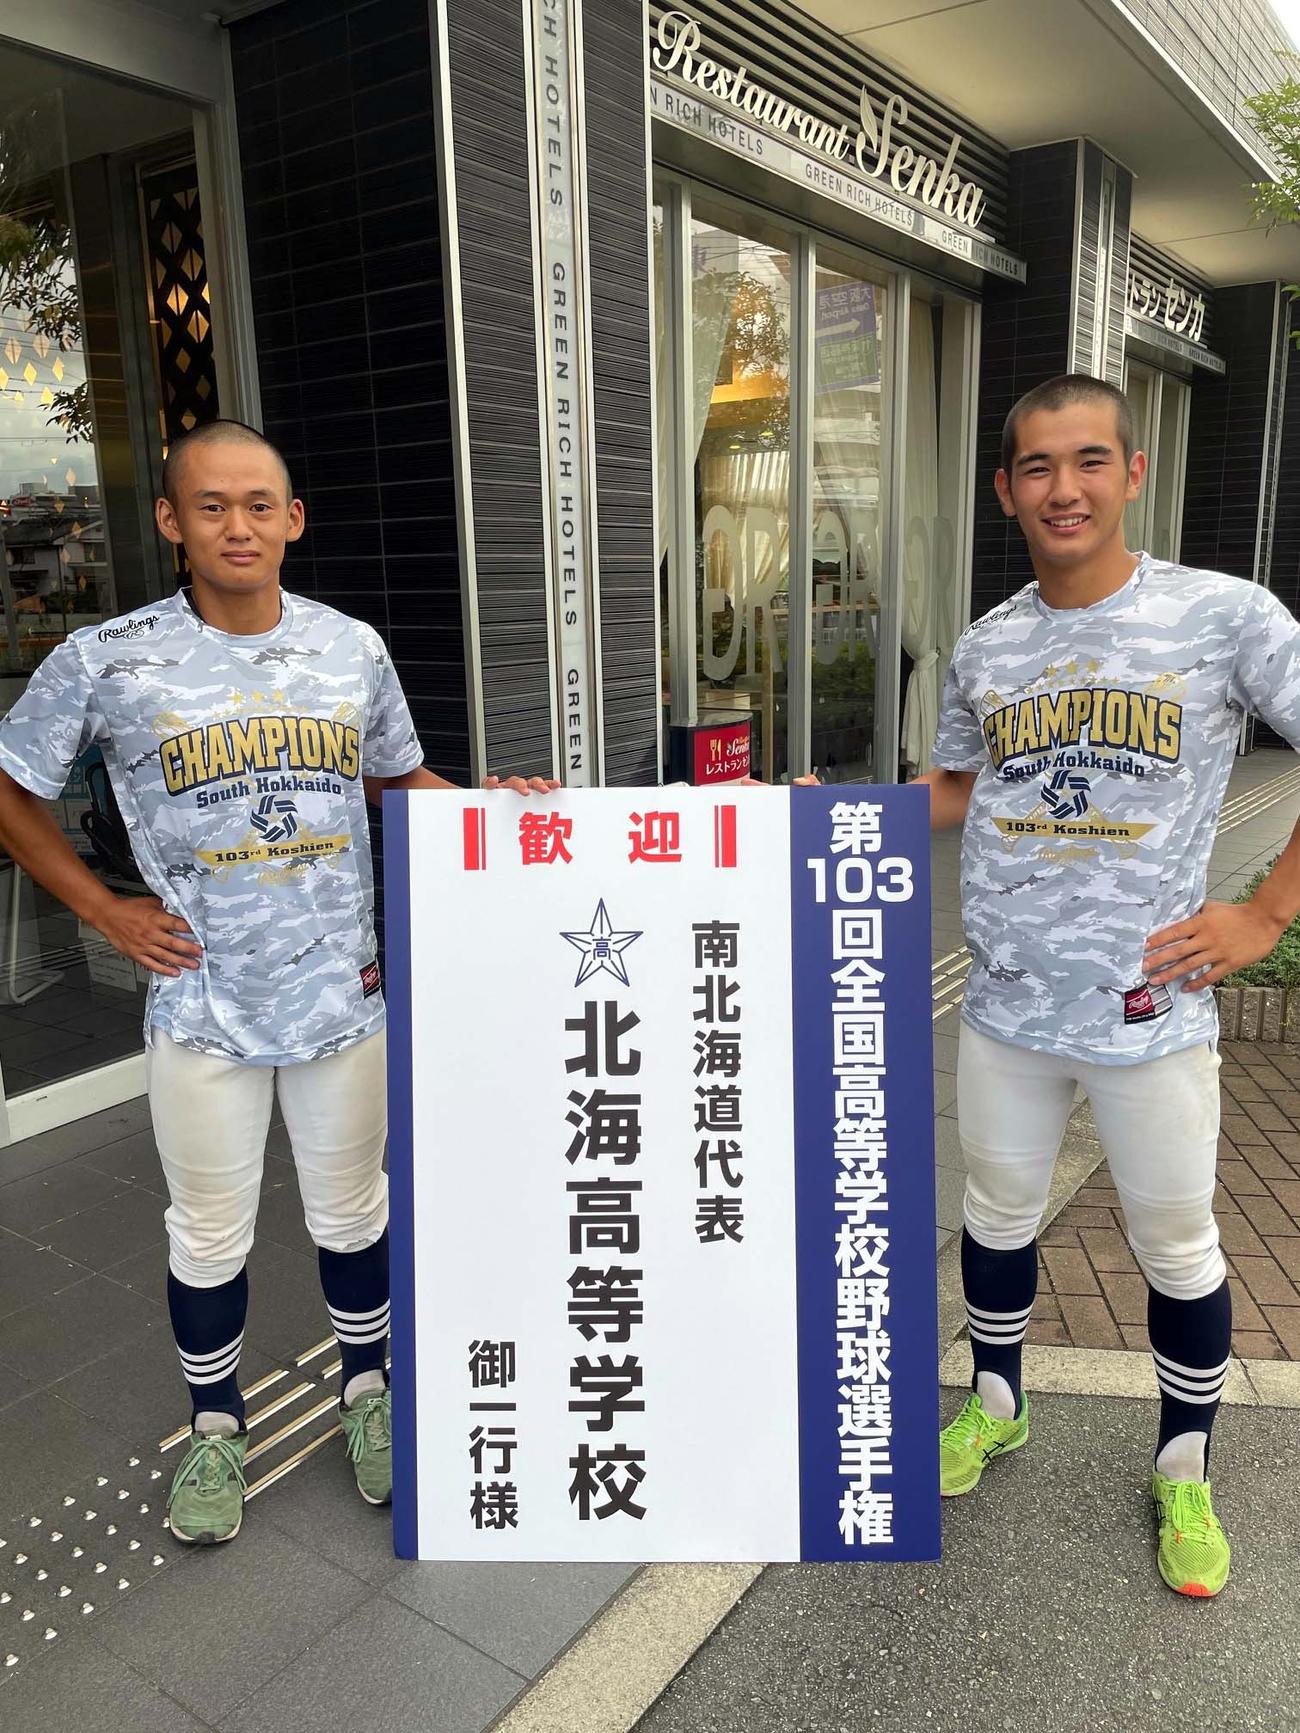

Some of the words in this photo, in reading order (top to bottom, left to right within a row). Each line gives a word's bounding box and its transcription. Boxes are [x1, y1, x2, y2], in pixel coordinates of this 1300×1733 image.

[545, 55, 563, 207] HOTELS
[653, 11, 850, 160] Restaurant
[855, 90, 987, 229] Senka
[665, 93, 700, 127] RICH
[708, 114, 763, 156] HOTELS
[805, 163, 842, 194] GREEN
[846, 183, 871, 207] RICH
[875, 199, 914, 227] HOTELS
[941, 230, 968, 254] GREEN
[990, 252, 1018, 276] HOTELS
[553, 262, 569, 380] GREEN
[557, 398, 572, 478] RICH
[560, 495, 577, 626] HOTELS
[98, 615, 160, 643] Rawlings
[159, 715, 360, 797] CHAMPIONS
[567, 668, 582, 770] GREEN
[982, 687, 1183, 772] CHAMPIONS
[196, 780, 251, 808] South
[256, 776, 342, 795] Hokkaido
[1002, 756, 1052, 782] South
[1052, 750, 1145, 778] Hokkaido
[215, 848, 262, 863] 103rd
[267, 841, 334, 857] Koshien
[1006, 821, 1047, 833] 103rd
[1053, 824, 1130, 836] Koshien
[591, 936, 612, 960] 高
[691, 920, 745, 1244] 南北海道代表
[806, 801, 914, 1546] 第103回全国高等学校野球選手権
[563, 1000, 647, 1521] 北海高等学校
[468, 1339, 519, 1530] 御一行様
